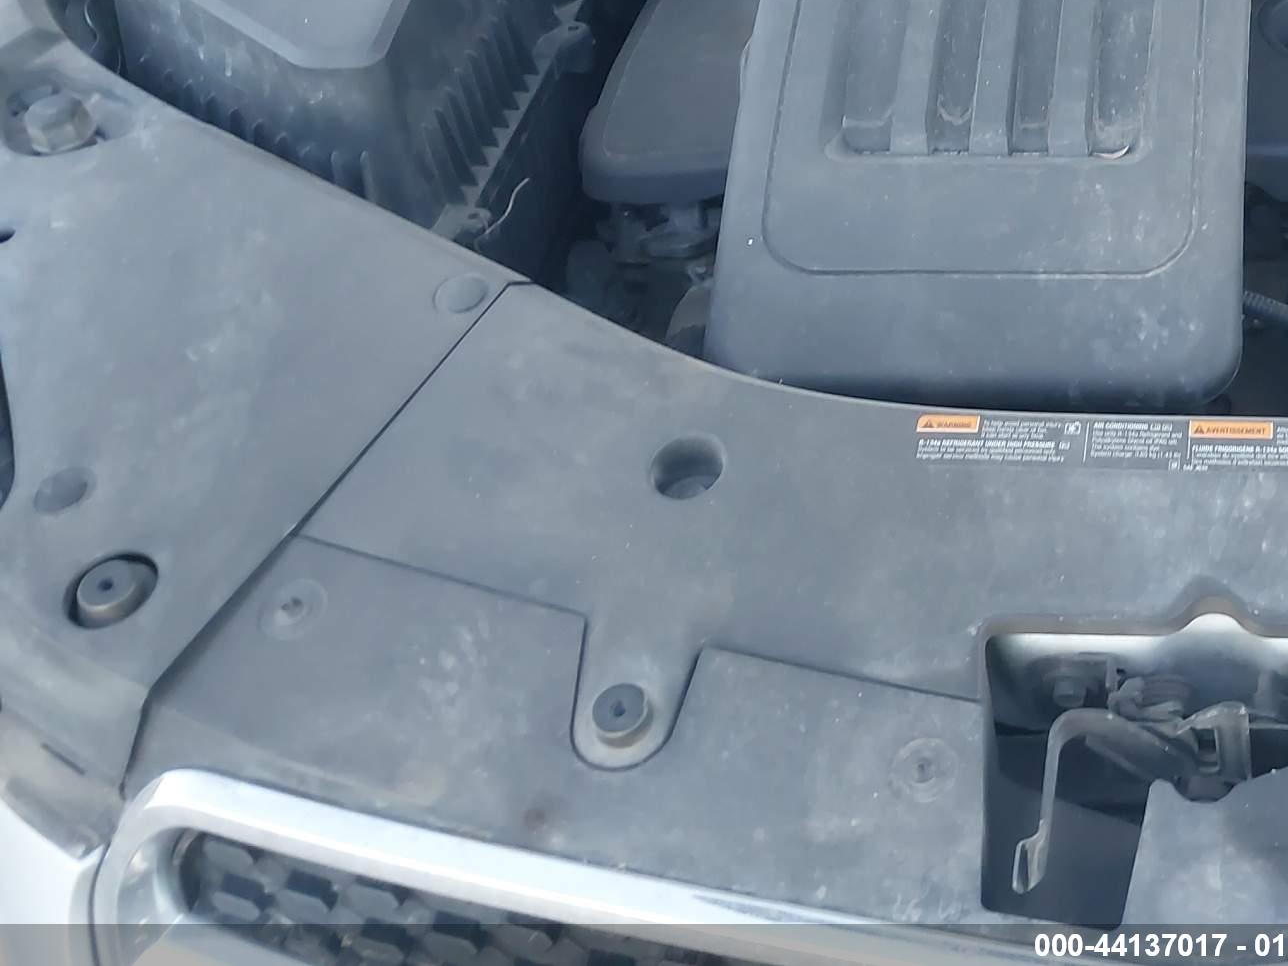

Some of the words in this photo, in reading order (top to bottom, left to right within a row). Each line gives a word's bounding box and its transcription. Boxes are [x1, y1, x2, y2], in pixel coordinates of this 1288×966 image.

[1105, 422, 1148, 430] CONDITIONING
[1206, 425, 1266, 435] AVERTISSEMENT
[1192, 444, 1213, 452] FLUIDE
